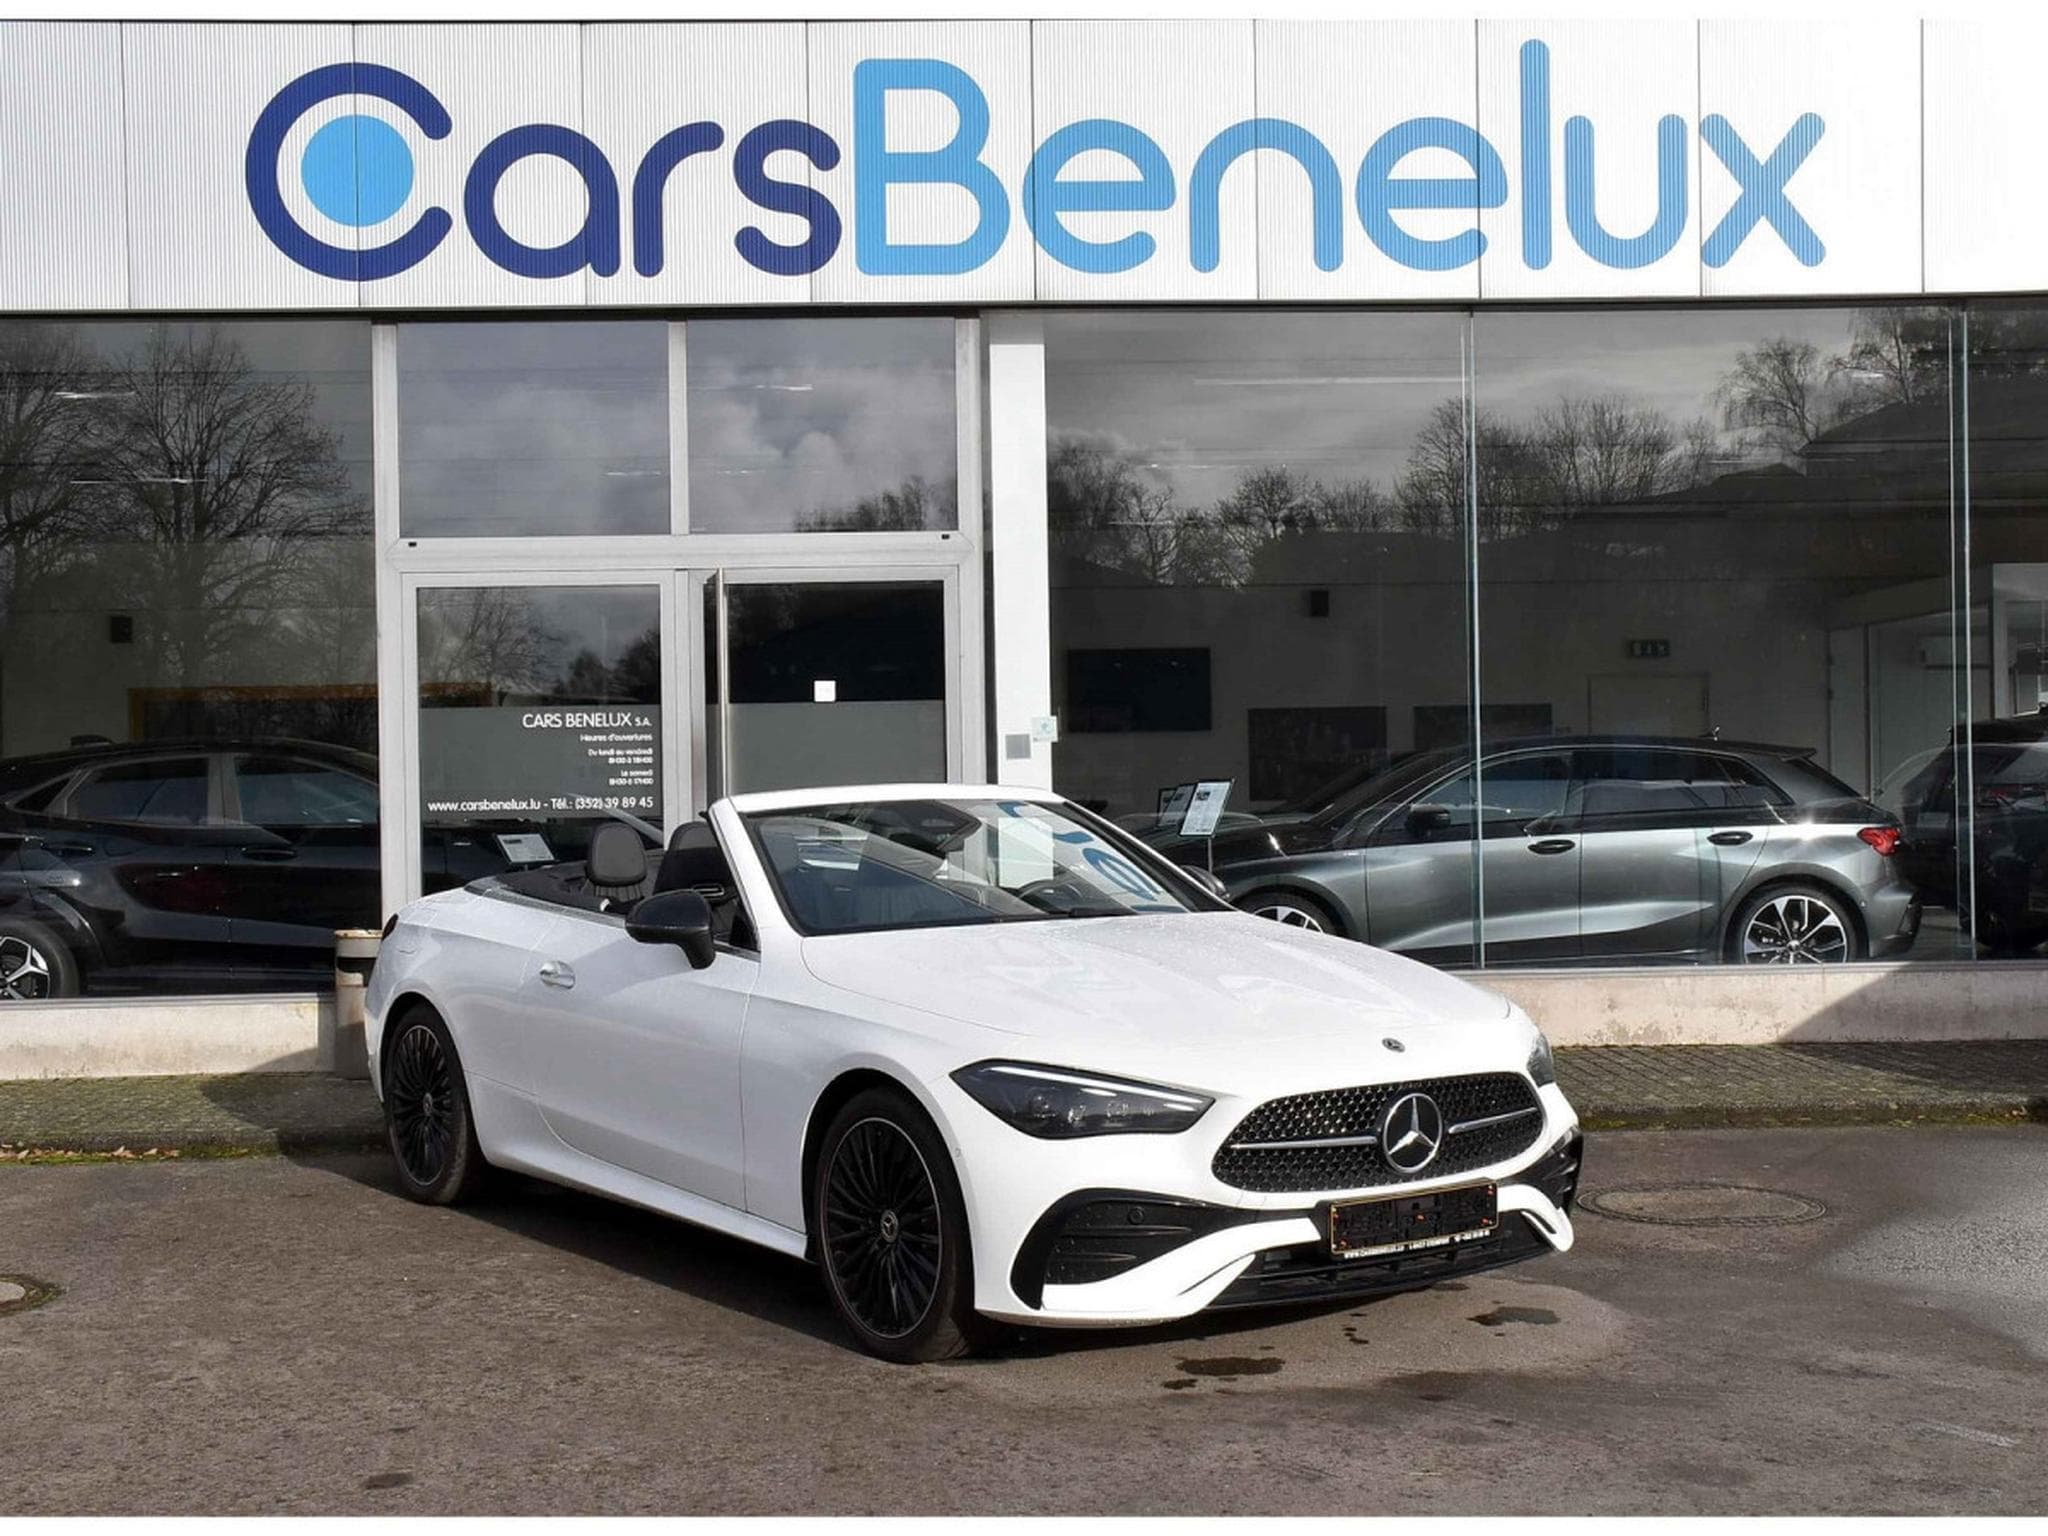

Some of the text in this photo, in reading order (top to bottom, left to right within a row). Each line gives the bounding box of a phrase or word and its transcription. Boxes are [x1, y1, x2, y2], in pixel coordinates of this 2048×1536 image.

[245, 38, 1827, 282] CarsBenelux
[522, 712, 563, 728] CARS
[565, 712, 632, 728] BENELUX
[580, 734, 607, 742] Heures
[599, 748, 615, 756] lundi
[626, 747, 653, 756] vendredi
[629, 769, 653, 777] samedi
[428, 798, 541, 812] www.carsbenelux.lu
[575, 796, 604, 810] (352)
[604, 796, 619, 809] 39
[622, 796, 637, 809] 89
[639, 796, 654, 809] 45
